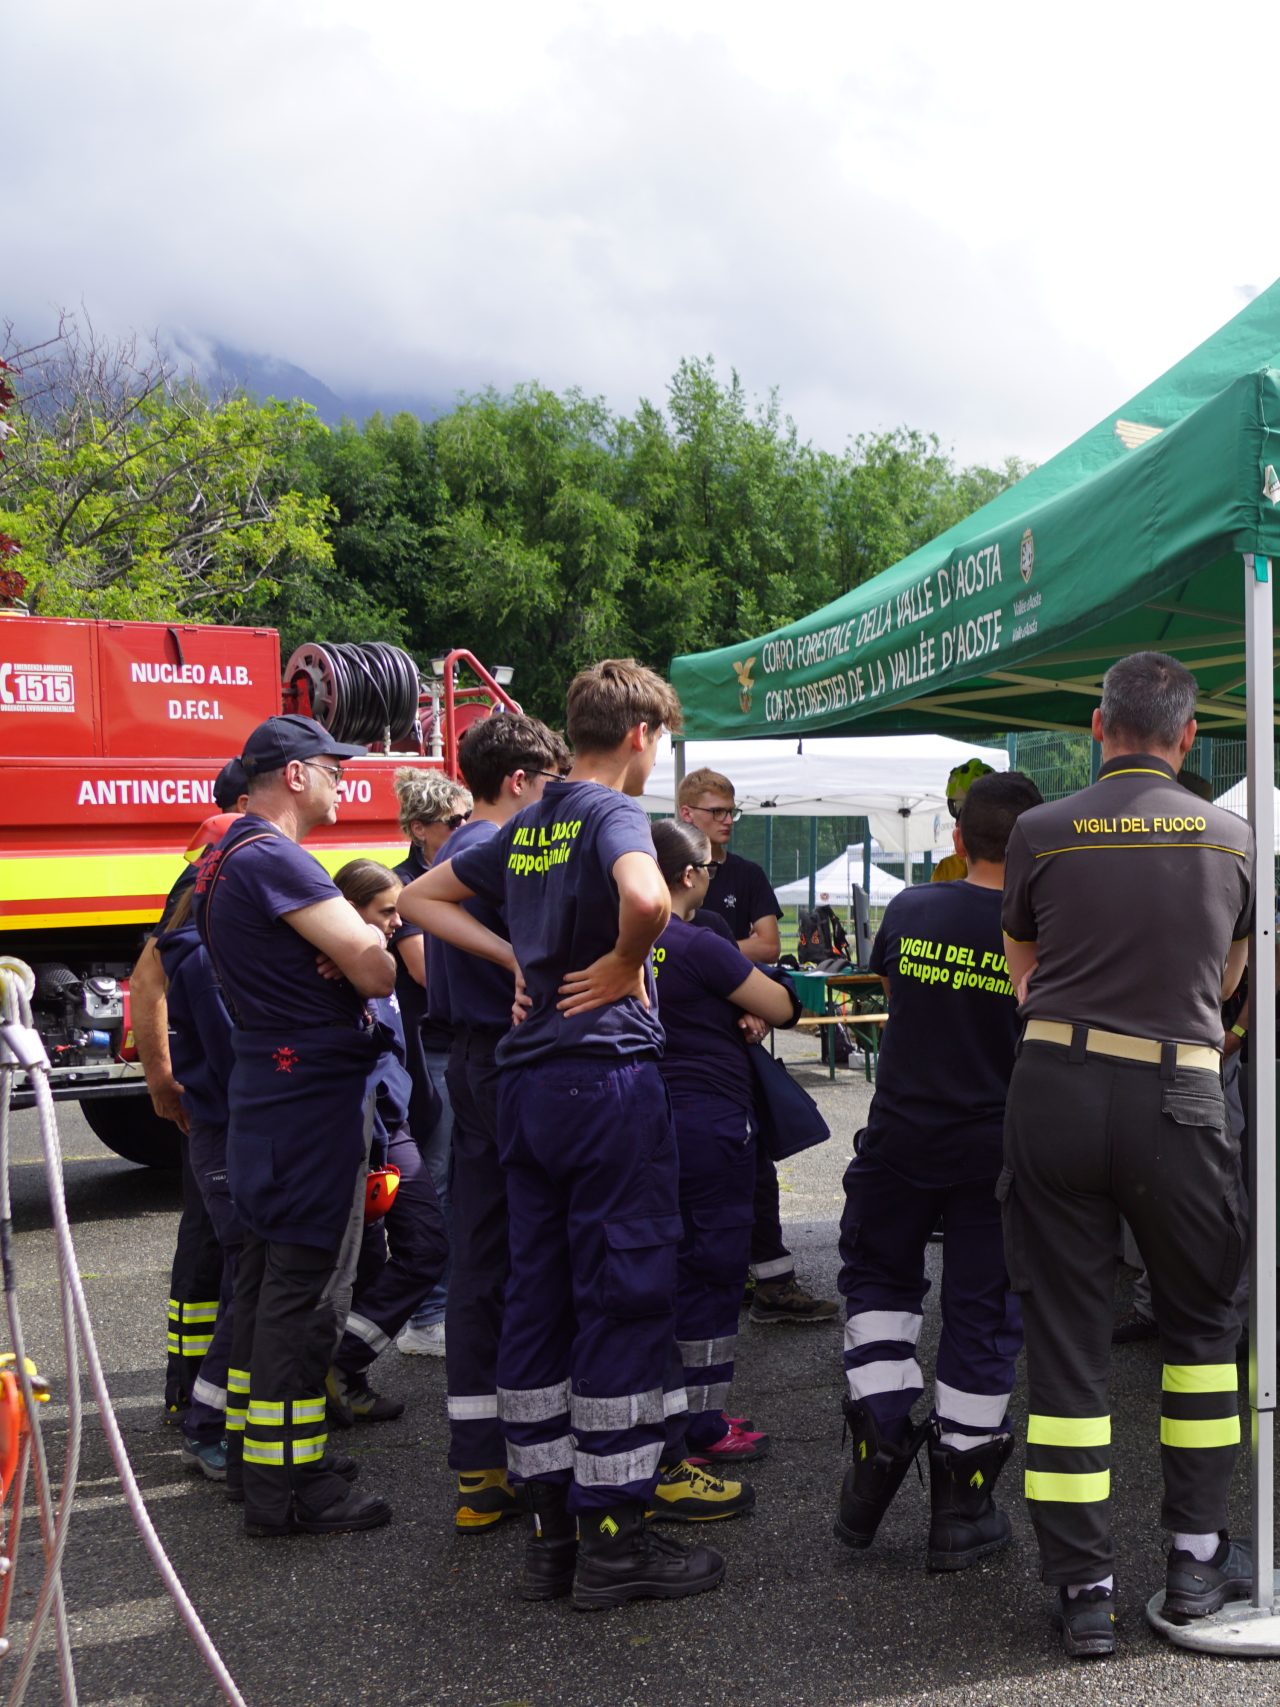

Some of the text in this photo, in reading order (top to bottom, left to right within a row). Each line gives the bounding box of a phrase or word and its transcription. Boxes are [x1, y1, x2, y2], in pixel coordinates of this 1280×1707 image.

[797, 619, 855, 668] FORESTALE
[855, 600, 892, 647] DELLA
[896, 576, 934, 628] VALLE
[937, 543, 1002, 609] D'AOSTA
[131, 663, 253, 685] NUCLEO A.I.B.
[795, 674, 848, 719] FORESTIER
[847, 666, 865, 705] DE
[868, 660, 886, 697] LA
[888, 631, 935, 690] VALLÉE
[941, 609, 1002, 670] D'AOSTE
[14, 674, 71, 702] 1515
[168, 700, 224, 720] D.F.C.I.
[1073, 816, 1206, 833] VIGILI DEL FUOCO
[900, 937, 942, 960] VIGILI
[945, 944, 976, 967] DEL
[899, 956, 1016, 997] Gruppo giovanil
